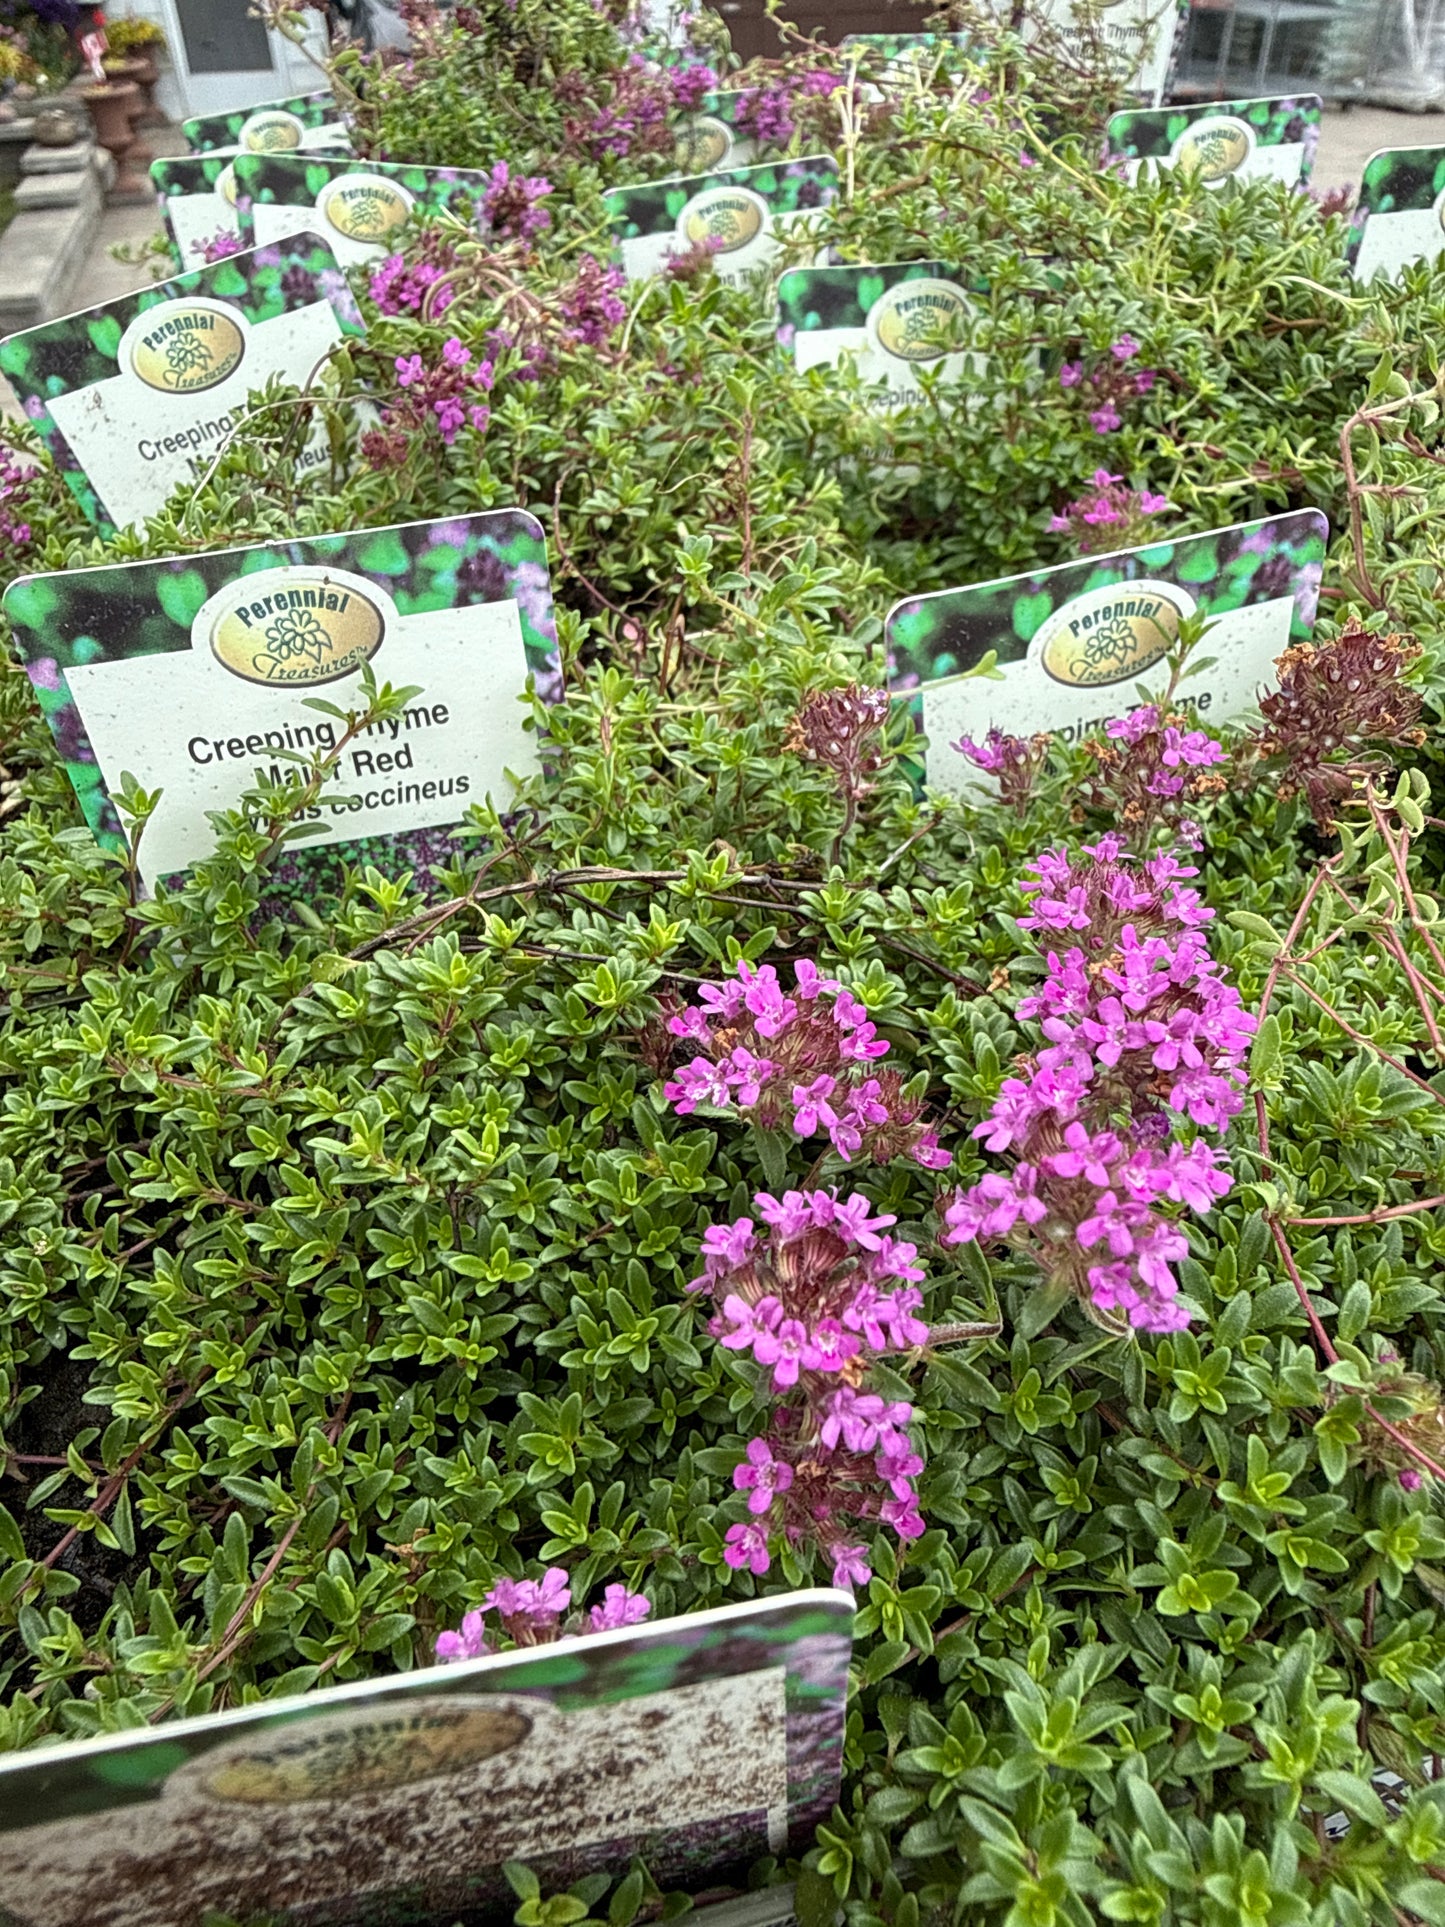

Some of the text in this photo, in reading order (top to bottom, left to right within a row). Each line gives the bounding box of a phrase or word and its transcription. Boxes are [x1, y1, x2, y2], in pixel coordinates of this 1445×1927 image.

[142, 312, 215, 352] Perennial
[234, 586, 351, 629] Perennial
[1068, 597, 1164, 639] Perennial
[187, 719, 337, 765] Creeping
[351, 742, 414, 777] Red
